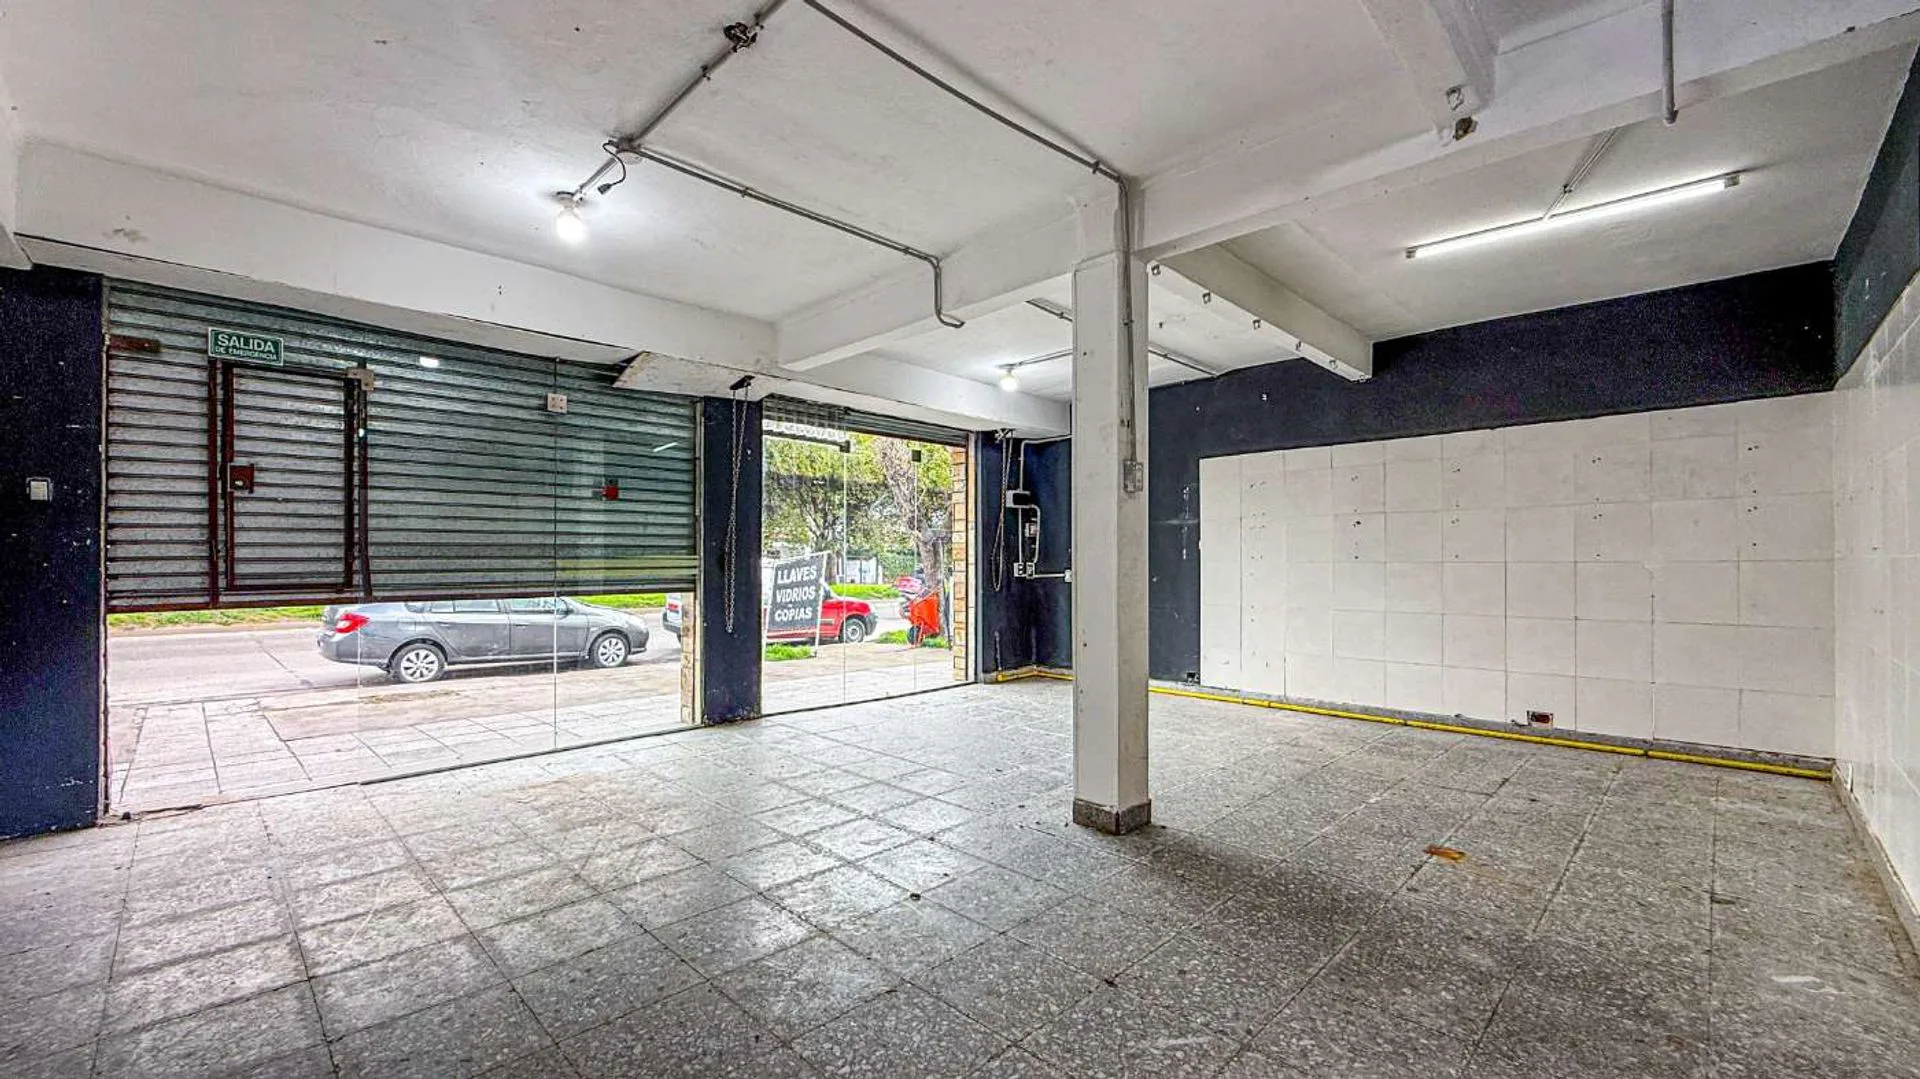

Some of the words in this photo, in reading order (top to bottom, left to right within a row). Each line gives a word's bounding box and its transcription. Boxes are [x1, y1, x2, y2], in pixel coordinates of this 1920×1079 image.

[217, 333, 275, 353] SALIDA
[776, 565, 817, 584] LLAVES
[776, 585, 816, 603] VIDRIOS
[774, 606, 813, 621] COPIAS
